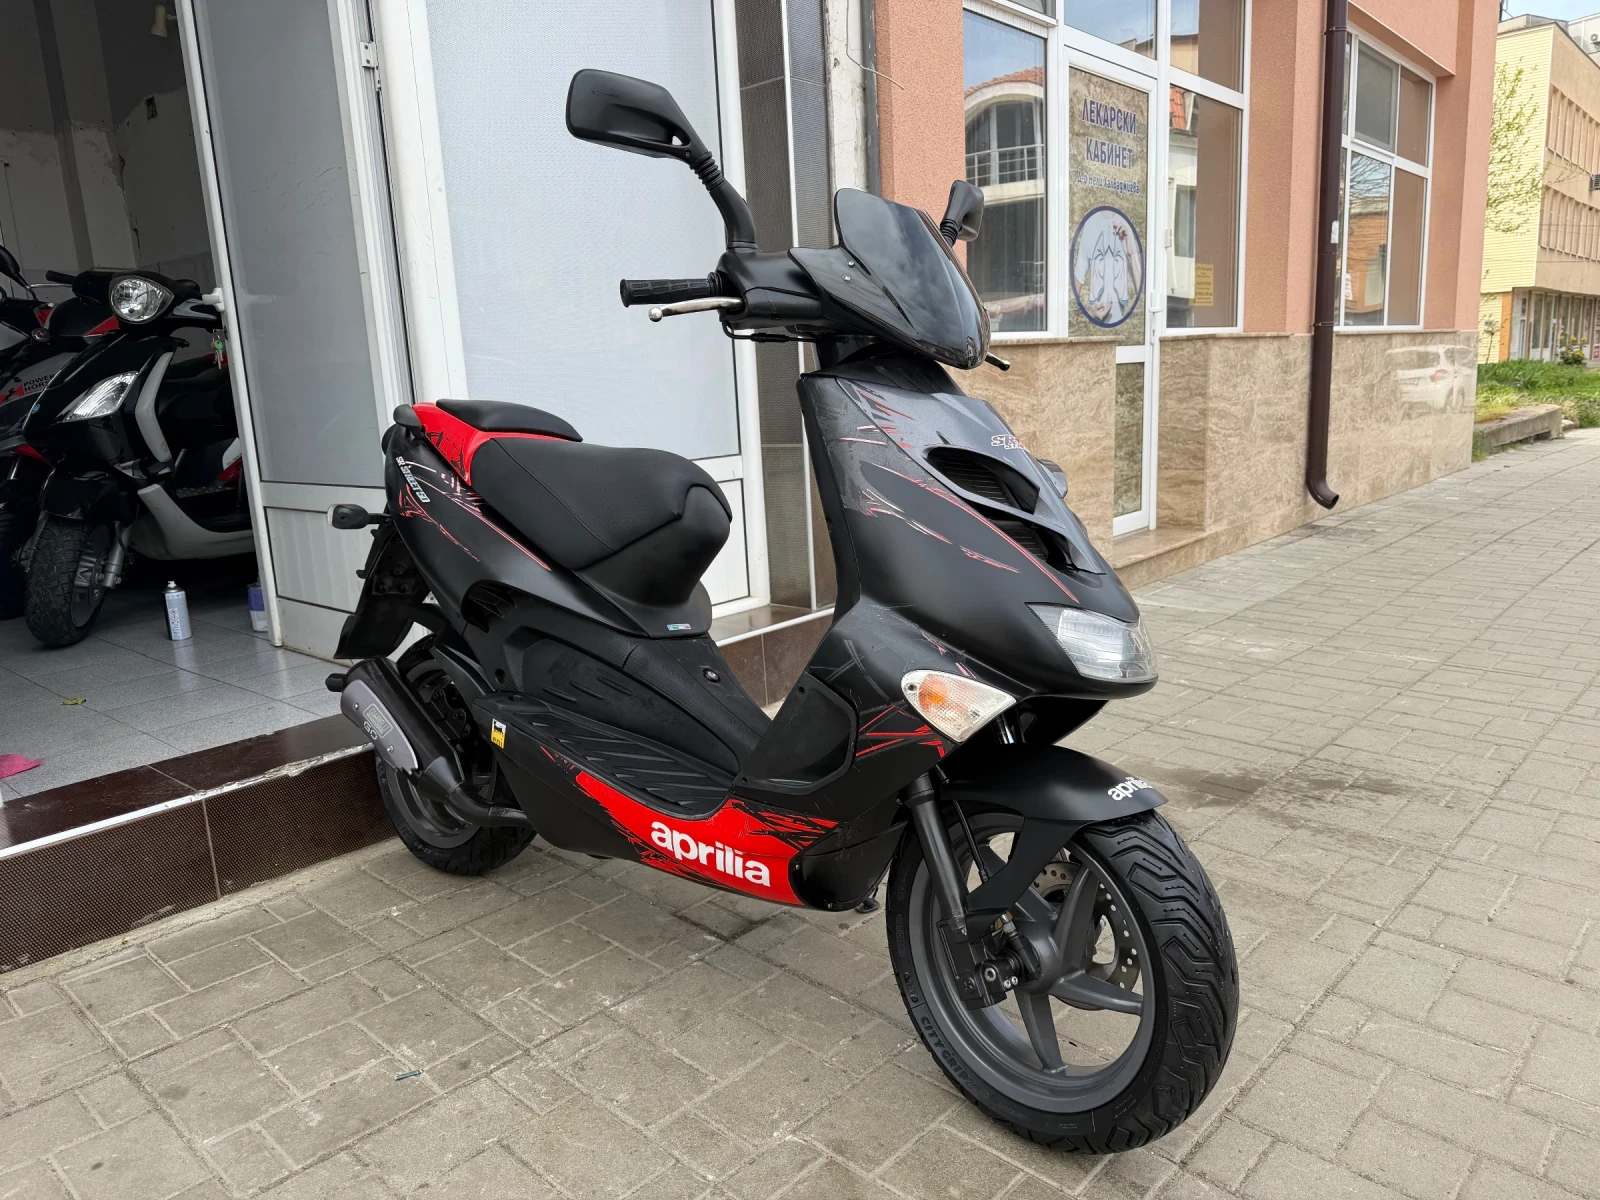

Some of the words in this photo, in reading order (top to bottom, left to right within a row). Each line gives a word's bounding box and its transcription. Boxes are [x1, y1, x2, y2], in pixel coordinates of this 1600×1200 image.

[1082, 98, 1137, 135] ЛЕКАРСКИ
[1086, 138, 1133, 170] КАБИНЕТ
[1088, 173, 1103, 188] Нели
[492, 736, 503, 747] eni
[651, 821, 771, 887] aprilia
[920, 1016, 946, 1049] CITY
[941, 1048, 970, 1082] GRIP
